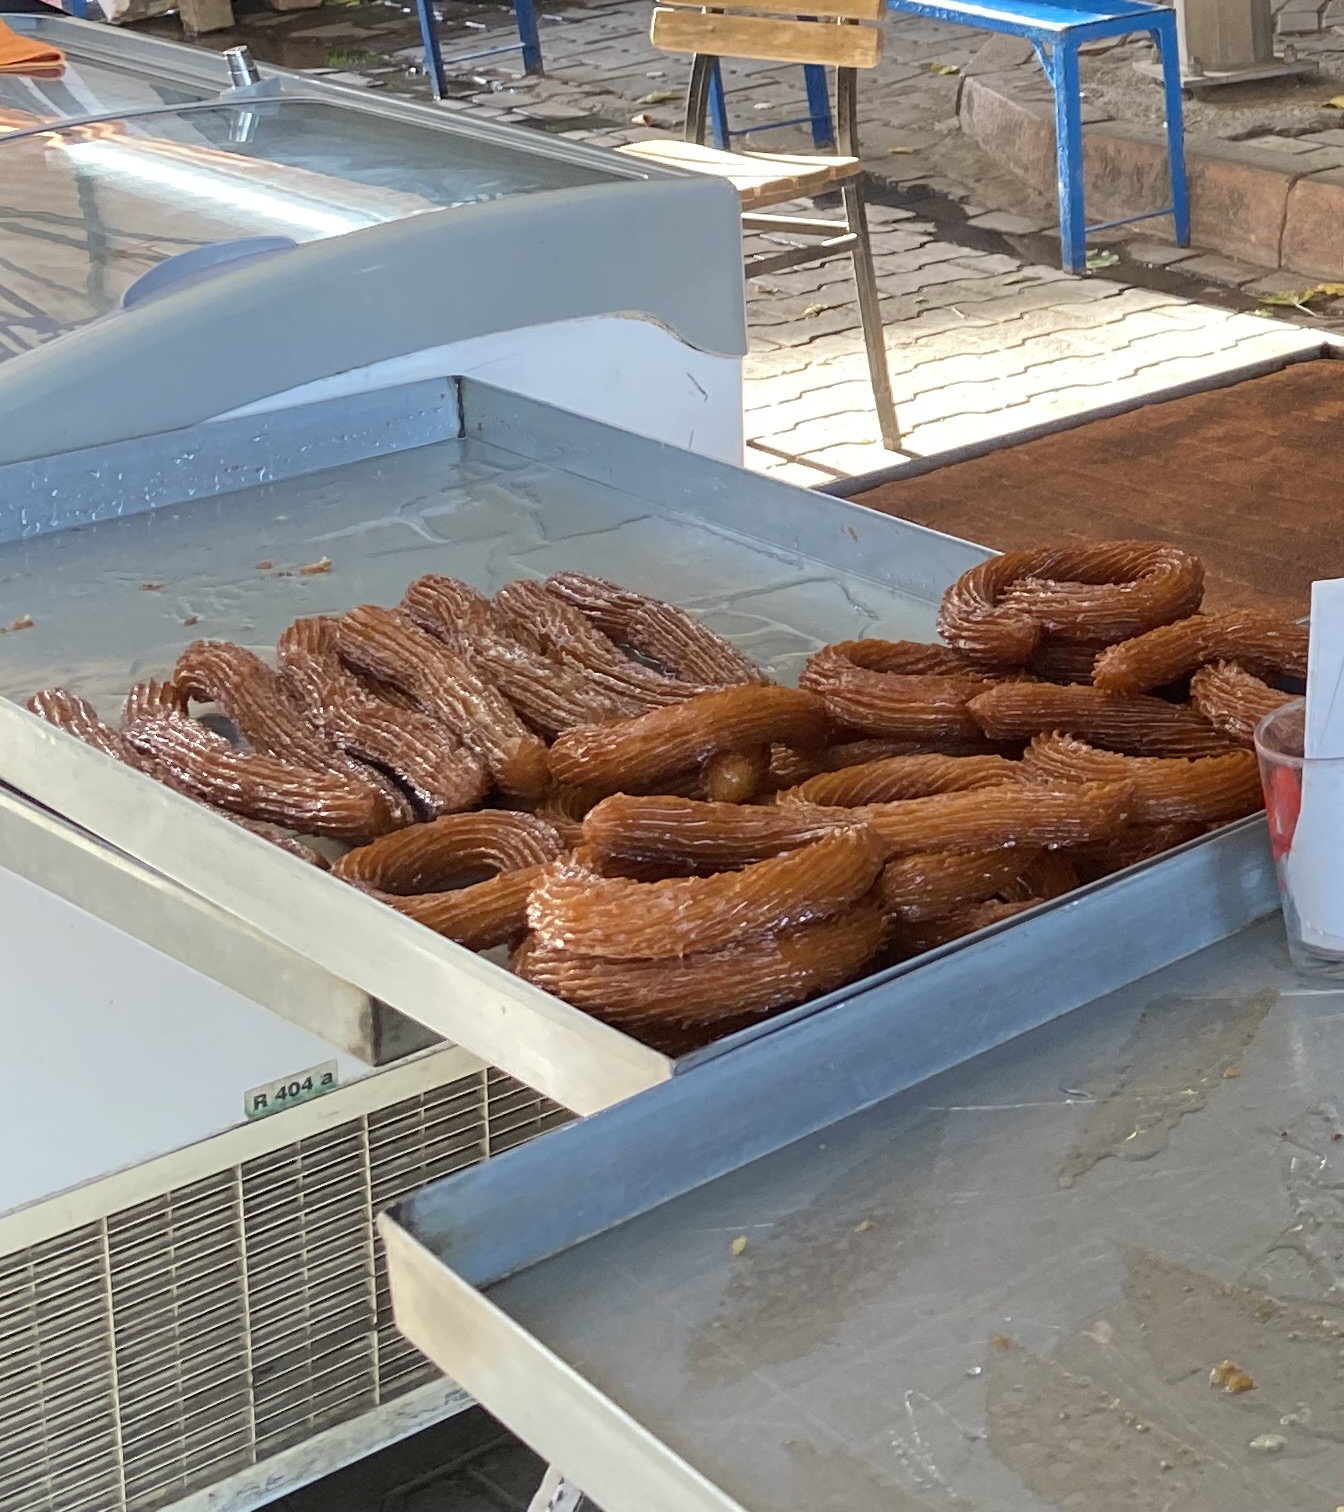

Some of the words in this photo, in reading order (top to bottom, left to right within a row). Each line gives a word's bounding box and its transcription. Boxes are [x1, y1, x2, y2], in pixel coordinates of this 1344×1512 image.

[253, 1093, 268, 1110] R
[274, 1076, 313, 1101] 404
[320, 1072, 334, 1086] a
